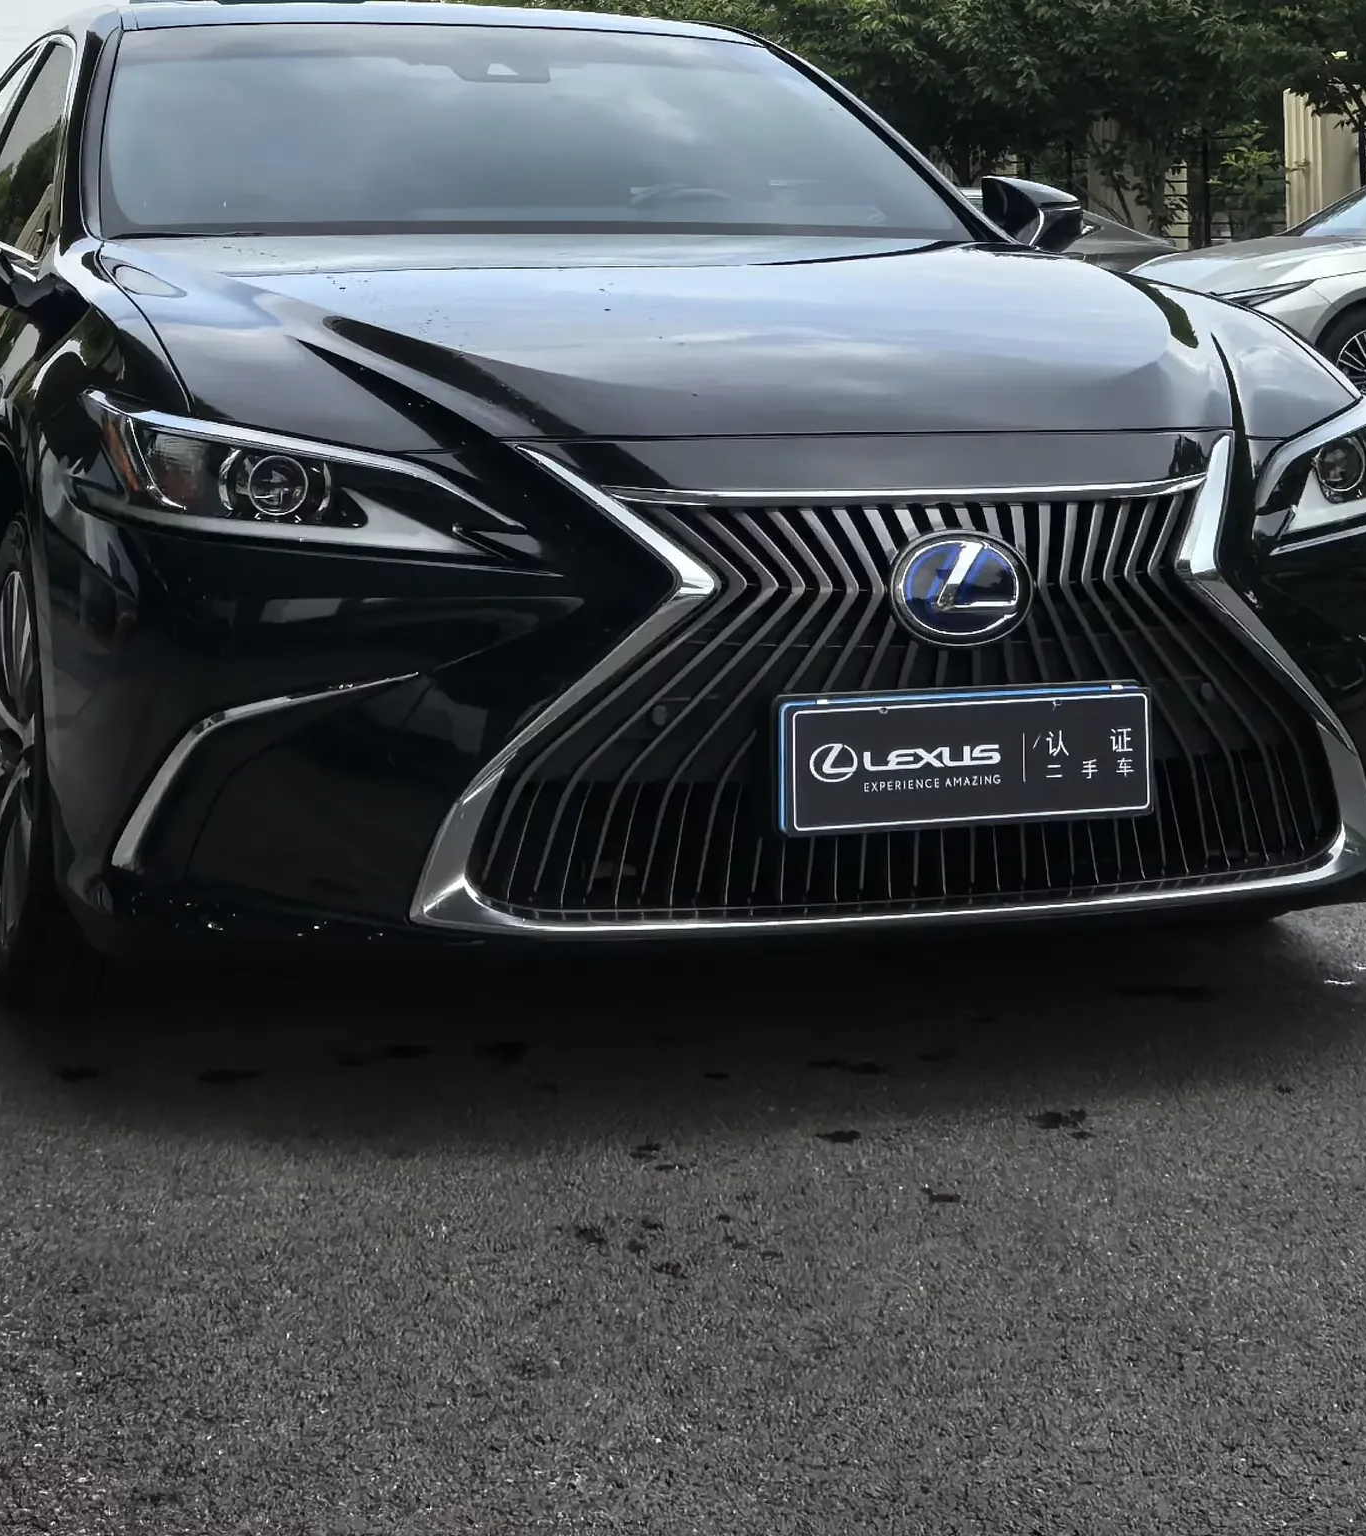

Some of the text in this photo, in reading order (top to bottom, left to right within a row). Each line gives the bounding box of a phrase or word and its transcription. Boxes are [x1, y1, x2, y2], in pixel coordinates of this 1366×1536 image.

[863, 744, 1001, 771] LEXUS
[1046, 758, 1134, 779] 二手车
[863, 774, 1002, 792] EXPERIENCE AMAZING
